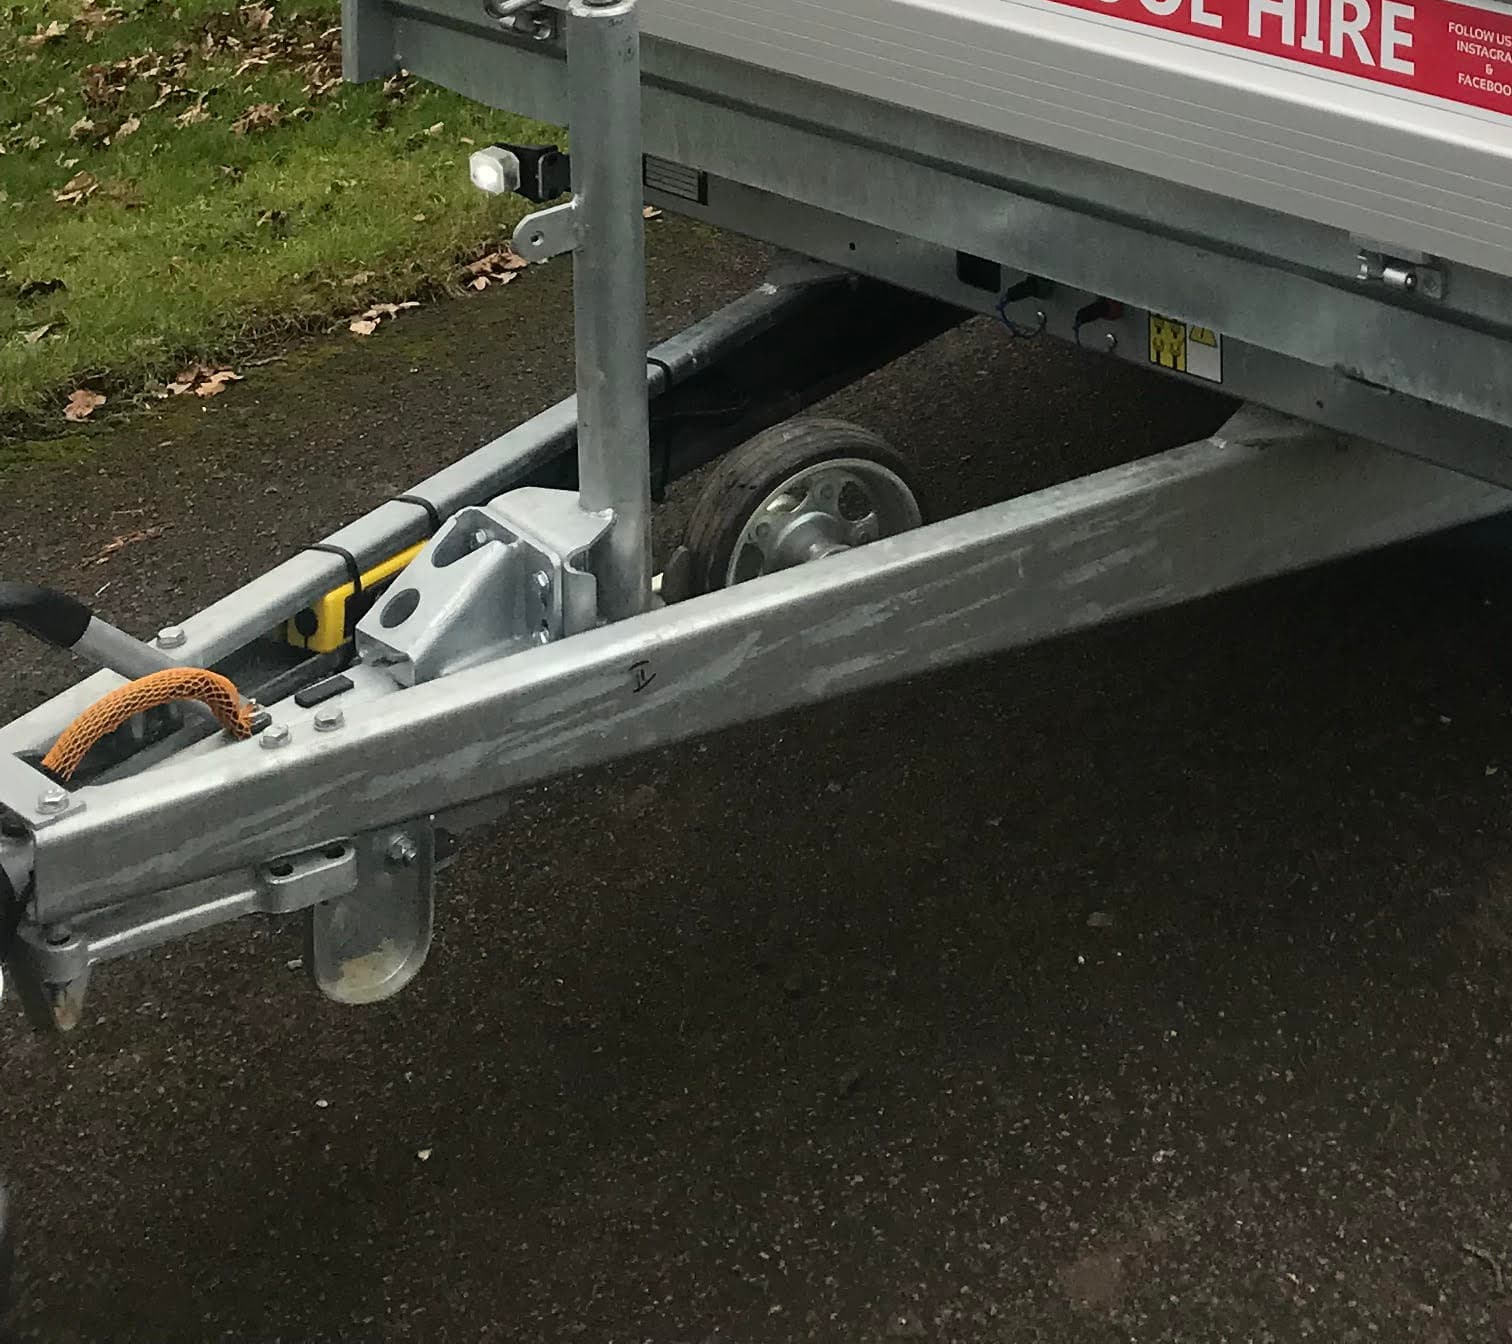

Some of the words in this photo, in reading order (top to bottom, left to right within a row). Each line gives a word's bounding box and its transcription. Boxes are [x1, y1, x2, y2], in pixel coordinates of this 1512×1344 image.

[1448, 21, 1495, 43] FOLLOW
[1496, 34, 1512, 48] US
[1485, 63, 1494, 75] &
